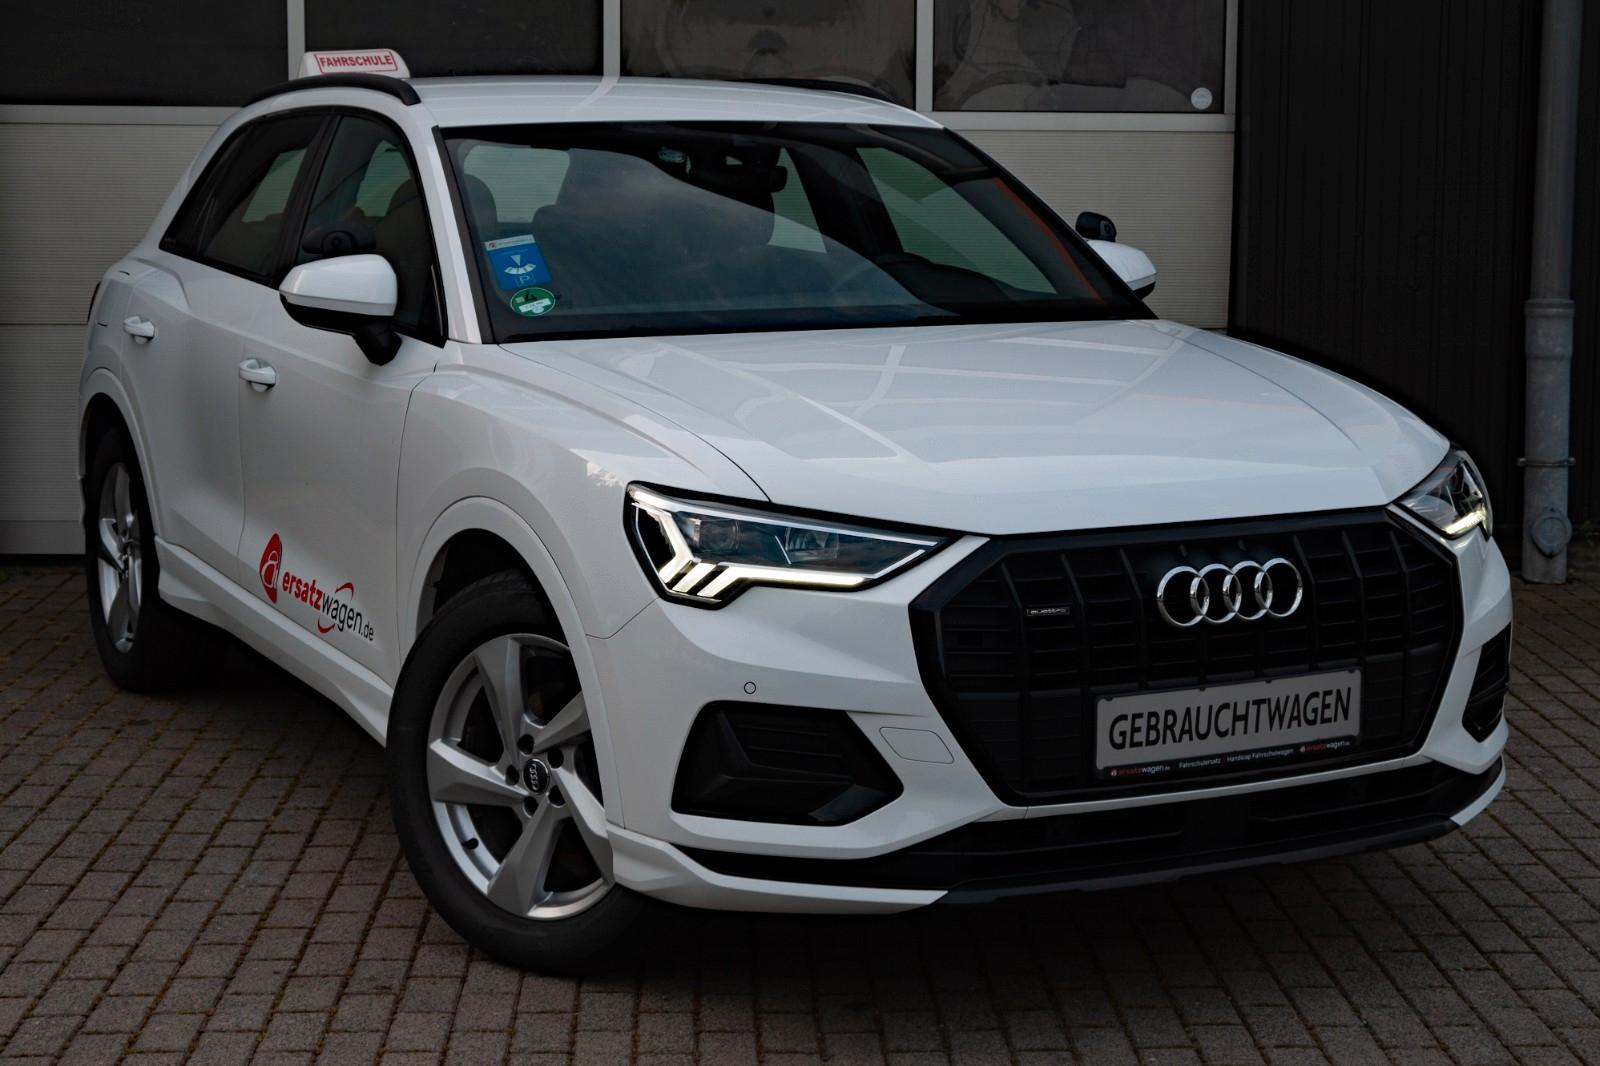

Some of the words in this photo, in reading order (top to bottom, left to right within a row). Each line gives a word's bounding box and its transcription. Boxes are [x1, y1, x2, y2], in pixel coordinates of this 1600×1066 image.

[319, 55, 393, 67] FAHRSCHULE
[282, 571, 374, 641] ersatzwagen.de
[1108, 687, 1352, 750] GEBRAUCHTWAGEN
